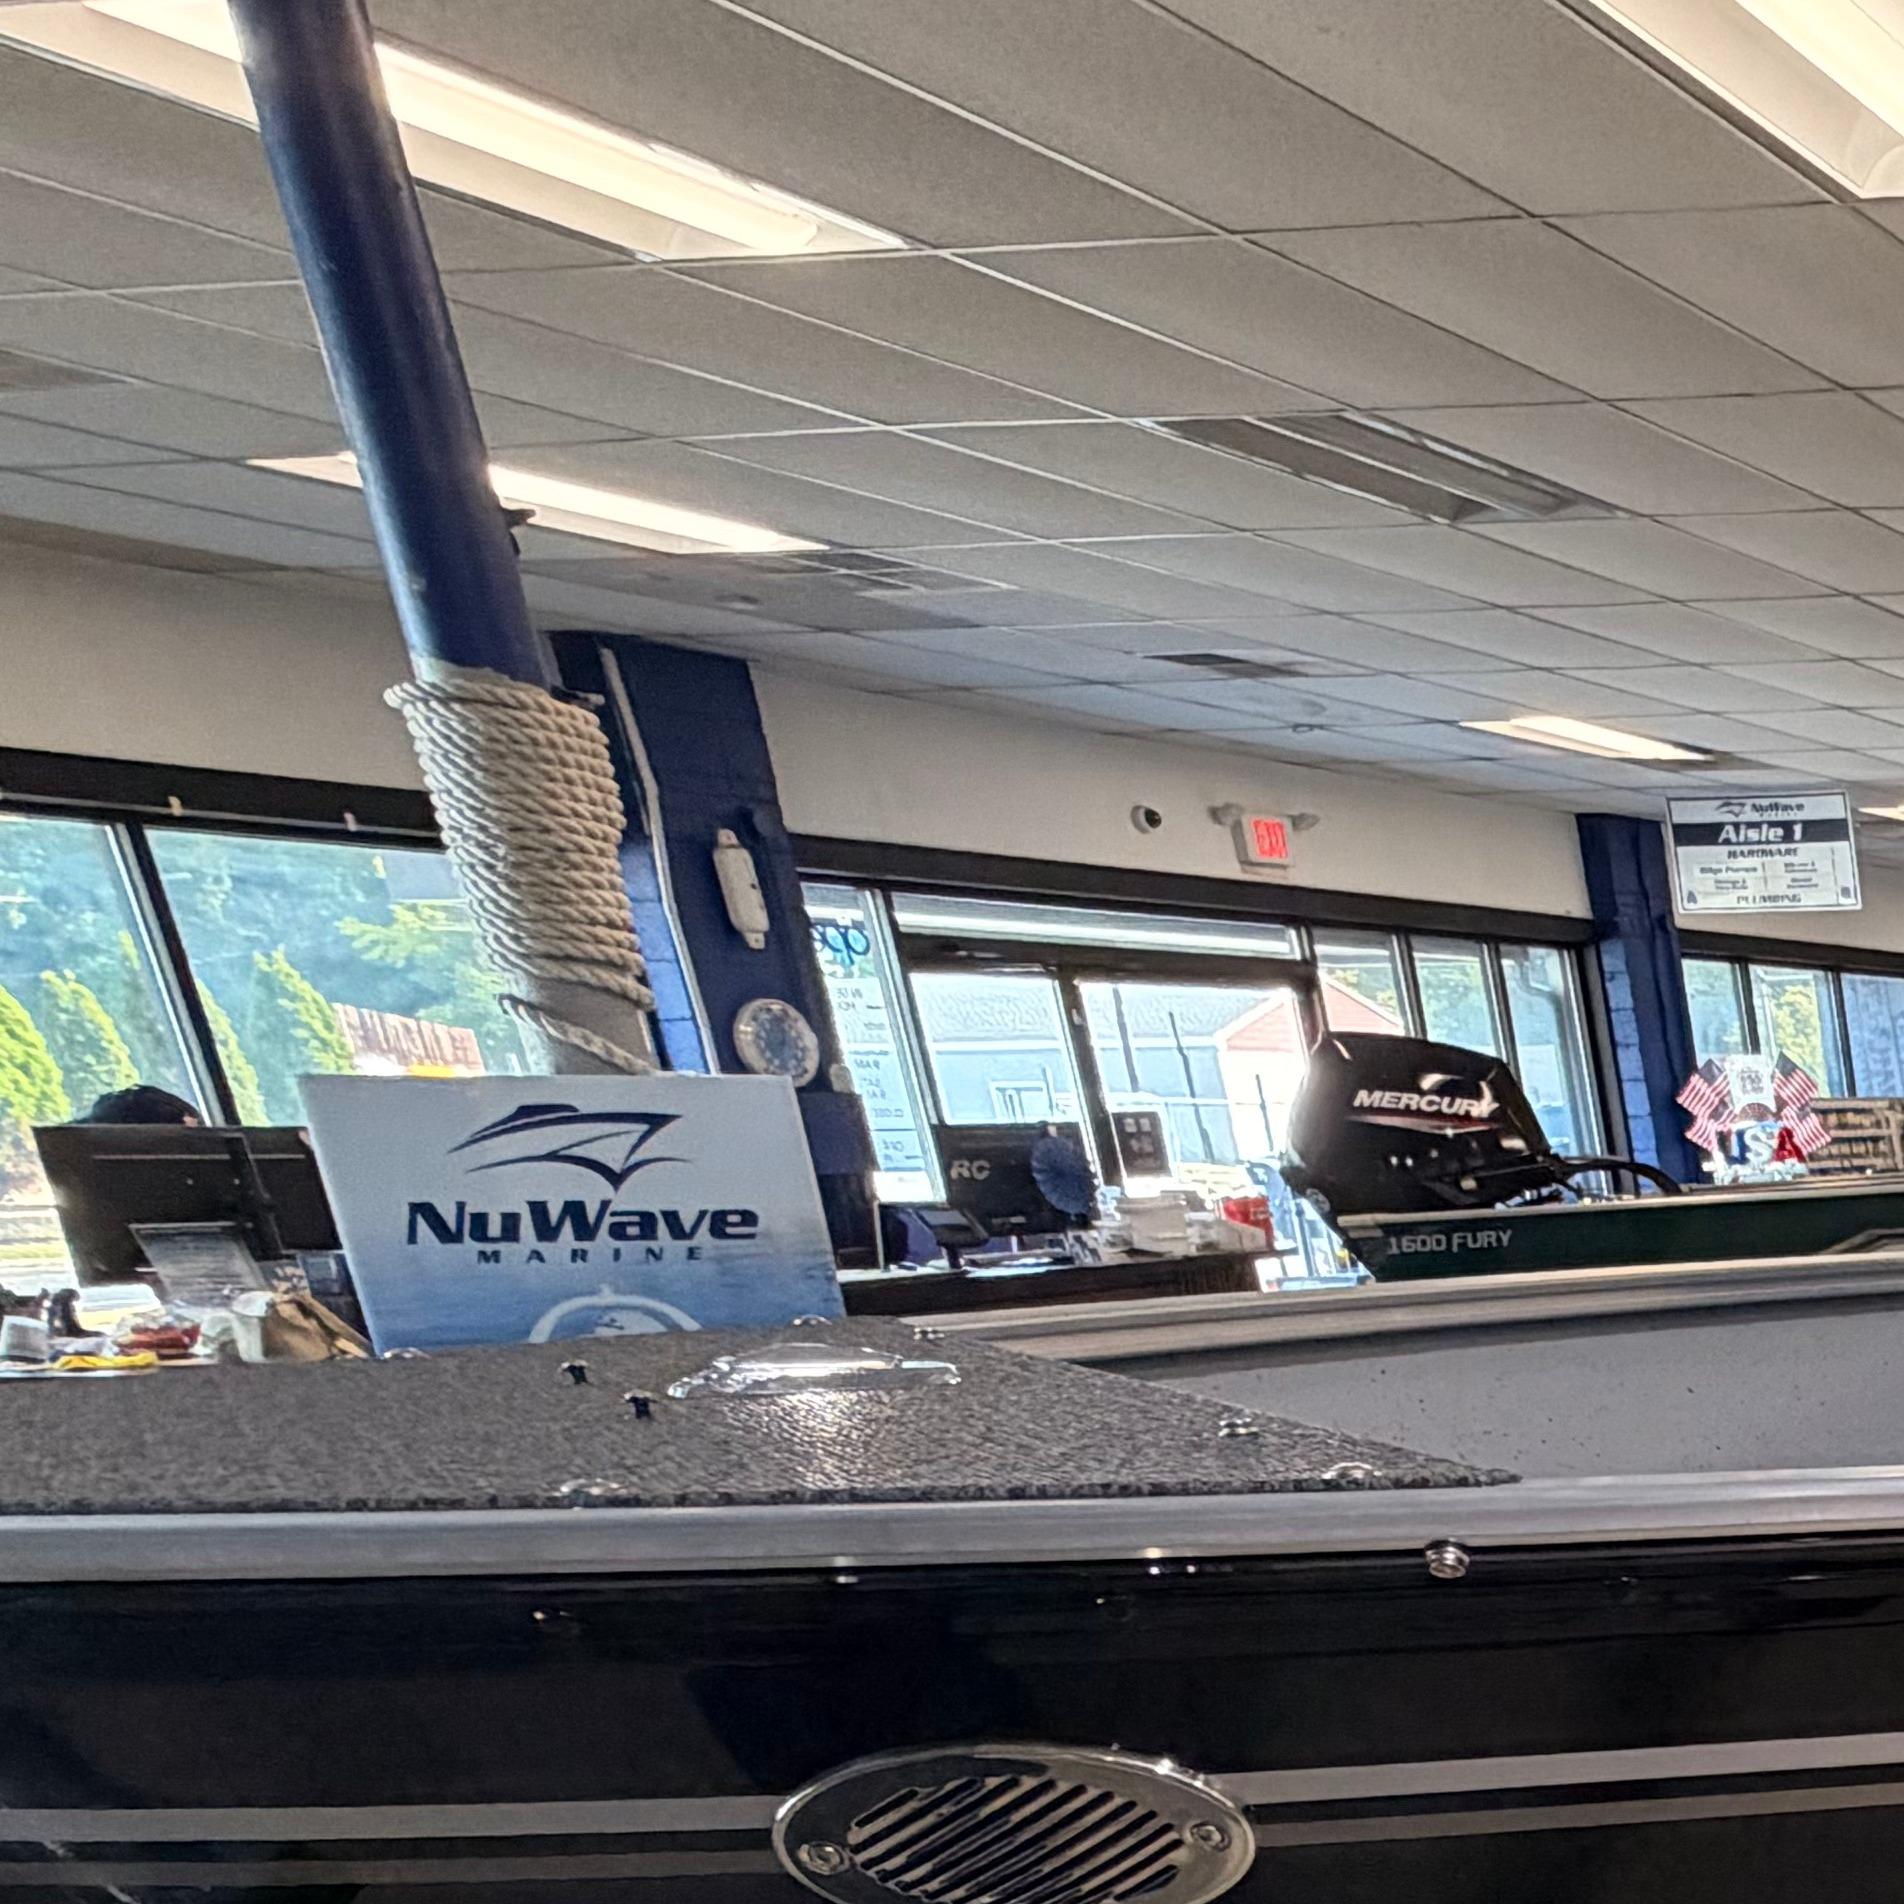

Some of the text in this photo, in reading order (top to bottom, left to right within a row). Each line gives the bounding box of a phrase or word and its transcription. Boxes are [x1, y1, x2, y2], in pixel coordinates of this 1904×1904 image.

[1717, 823, 1803, 844] Aisle 1
[1352, 1089, 1500, 1119] MERCURY
[407, 1200, 760, 1246] NuWave
[1386, 1228, 1513, 1255] 1600 FURY
[476, 1246, 705, 1265] MARINE
